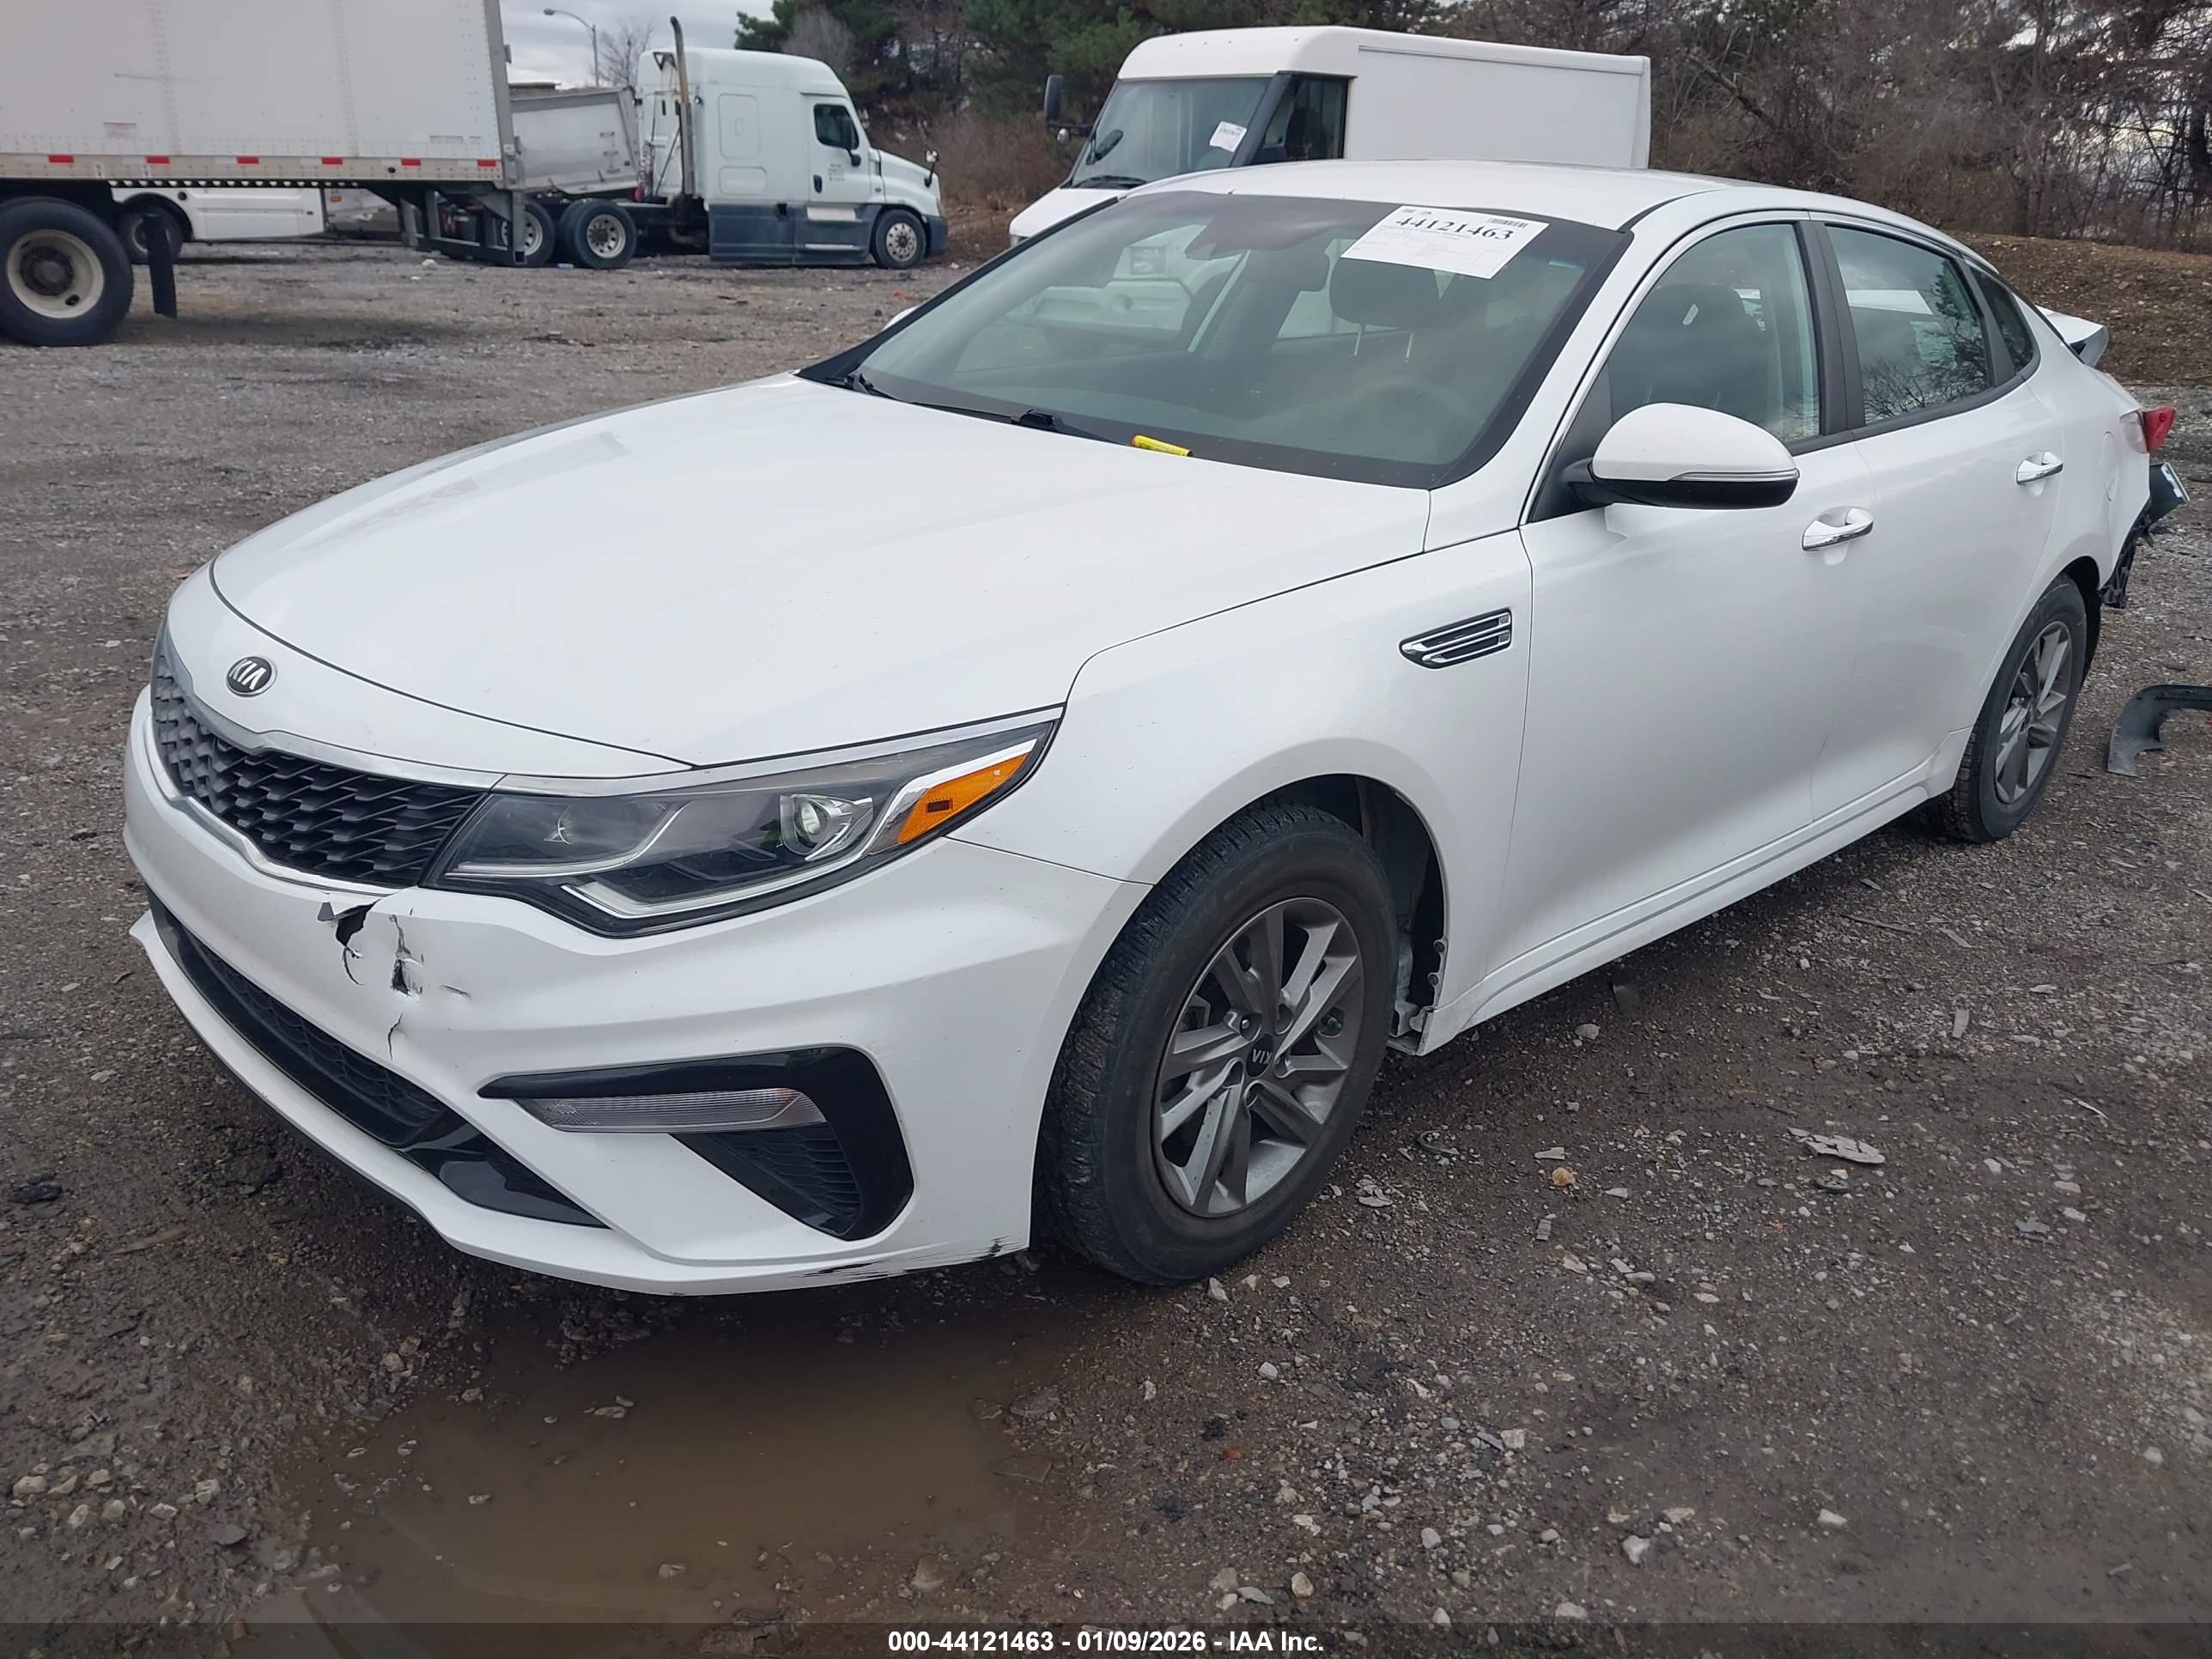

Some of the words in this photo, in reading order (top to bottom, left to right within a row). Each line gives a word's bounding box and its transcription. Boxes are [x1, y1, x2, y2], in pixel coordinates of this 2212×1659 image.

[1395, 216, 1514, 240] 44121463
[228, 659, 267, 690] KIA
[1252, 1048, 1273, 1065] KIA
